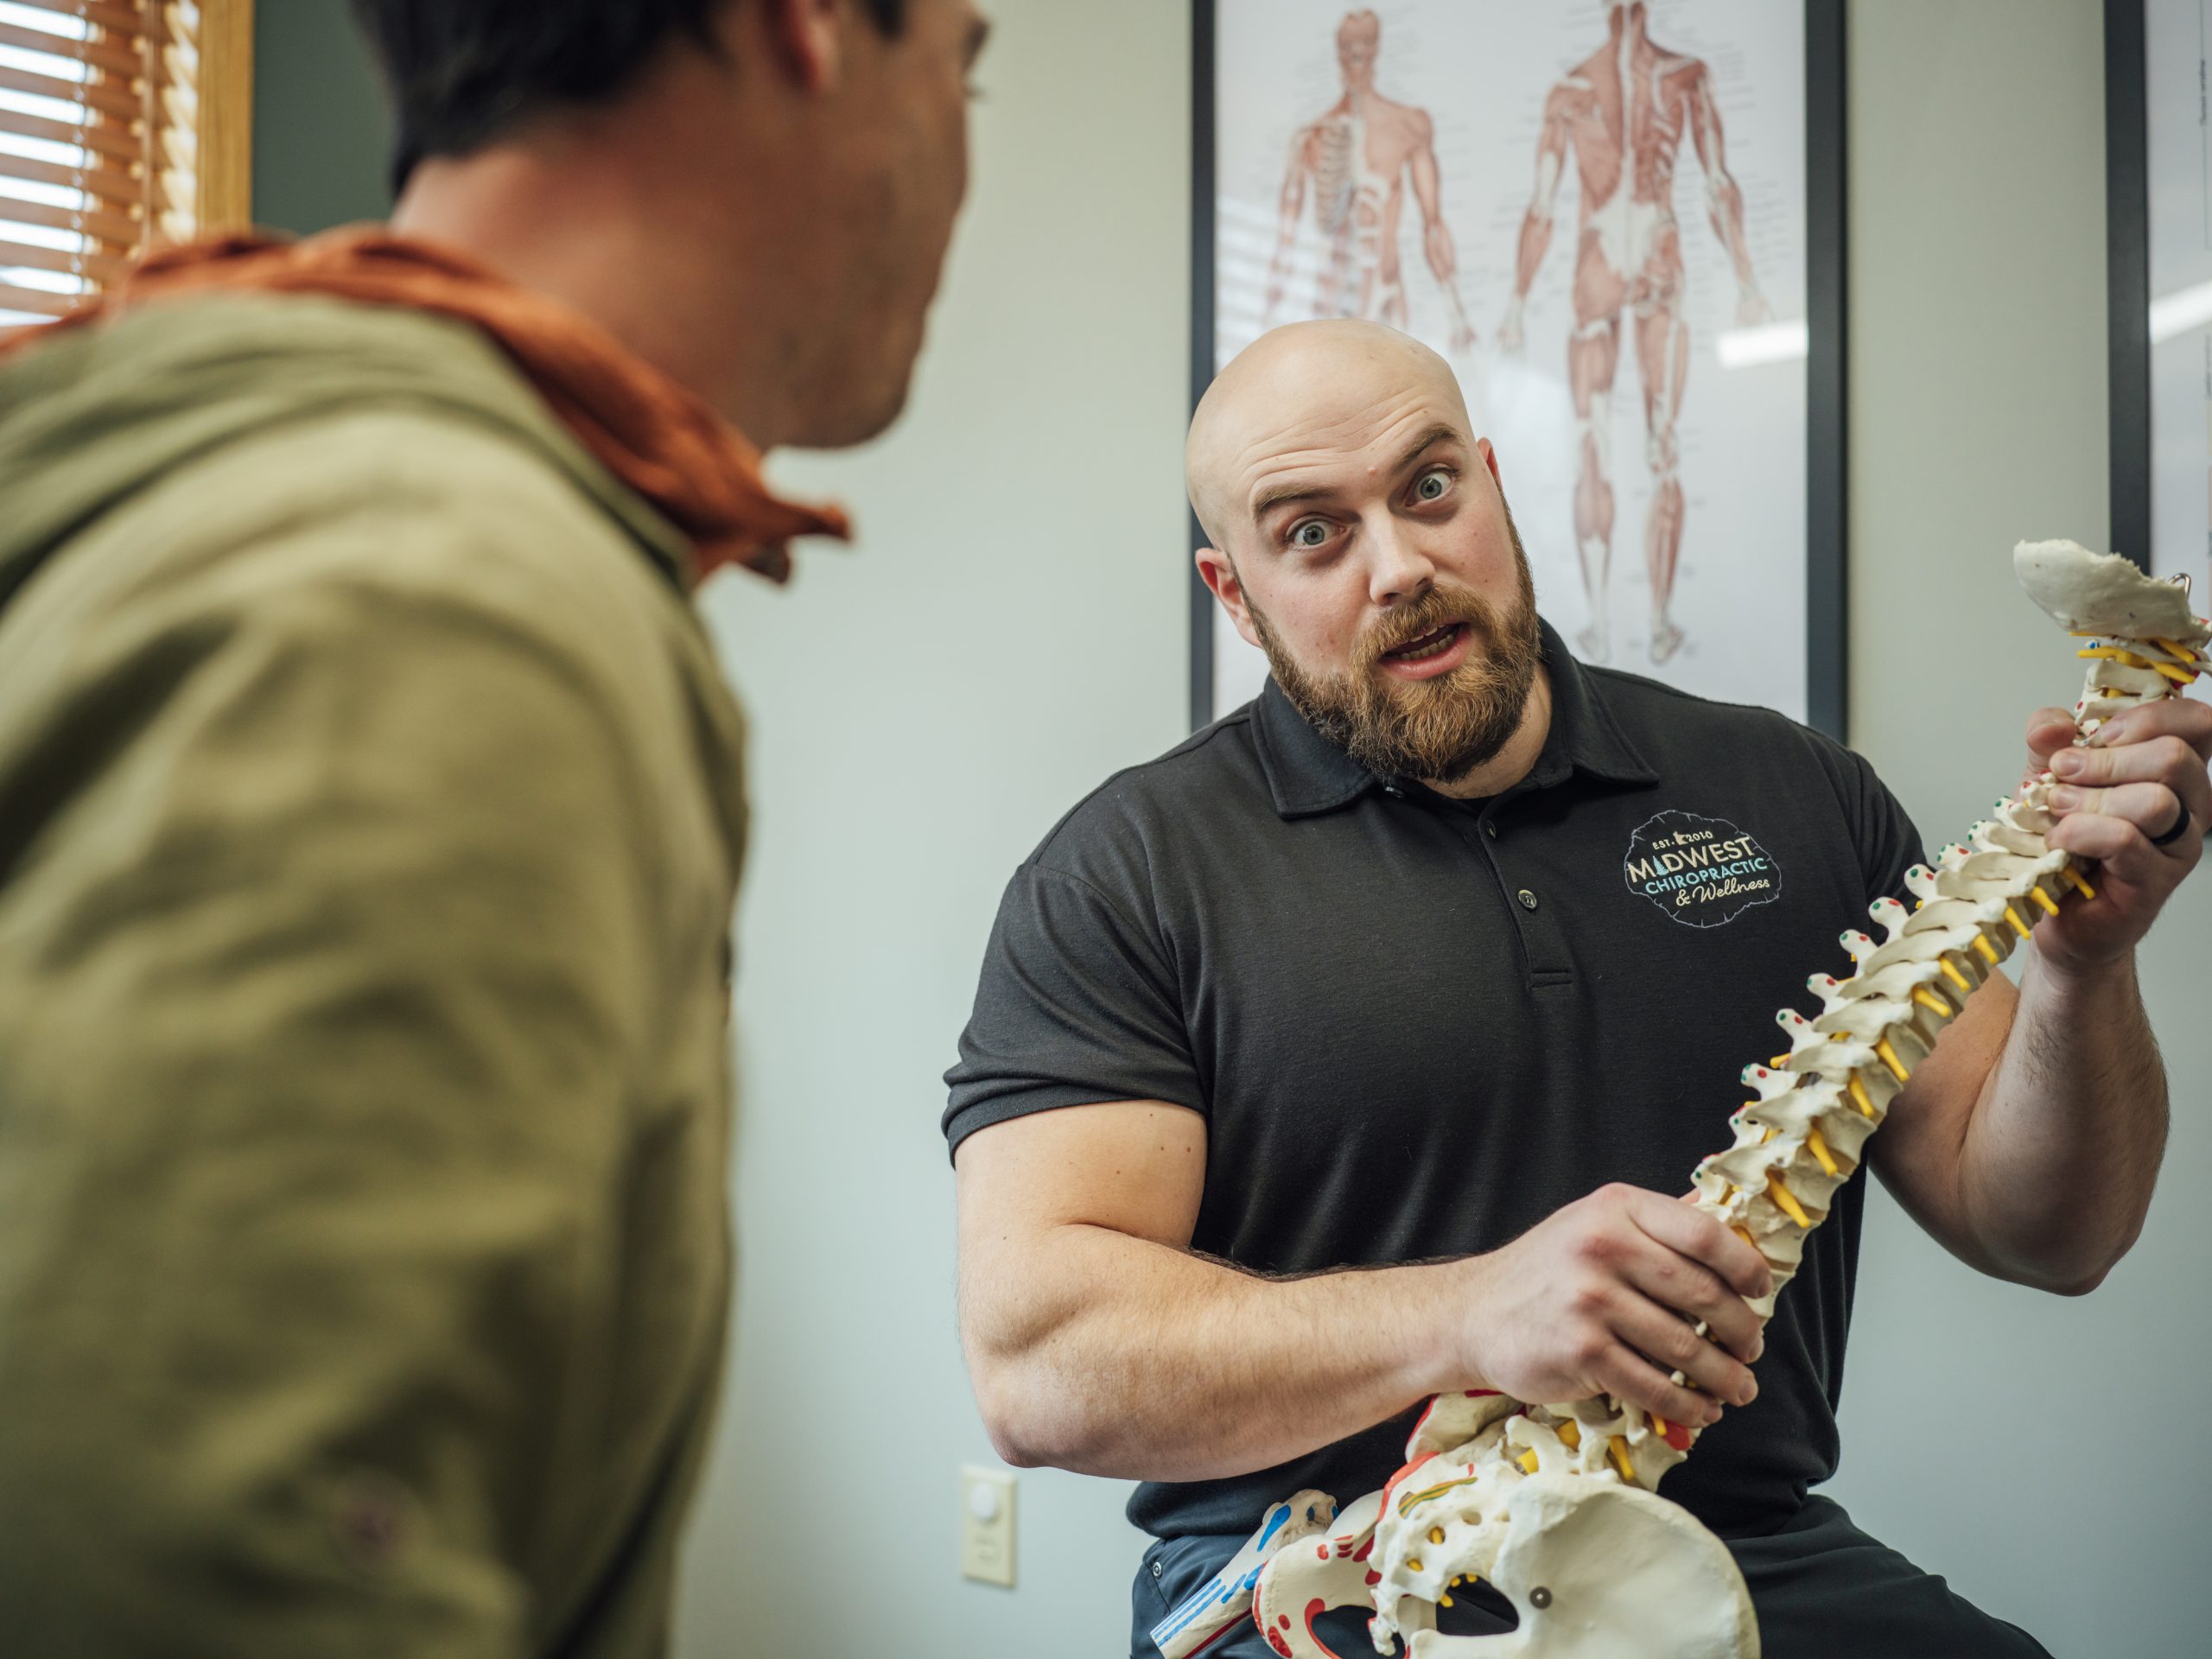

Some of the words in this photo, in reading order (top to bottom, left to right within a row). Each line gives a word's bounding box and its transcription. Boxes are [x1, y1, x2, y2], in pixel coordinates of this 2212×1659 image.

[1652, 838, 1675, 850] EST.
[1686, 830, 1713, 842] 2010
[1644, 857, 1768, 894] CHIROPRACTIC
[1675, 889, 1691, 906] &
[1692, 877, 1770, 903] Wellness
